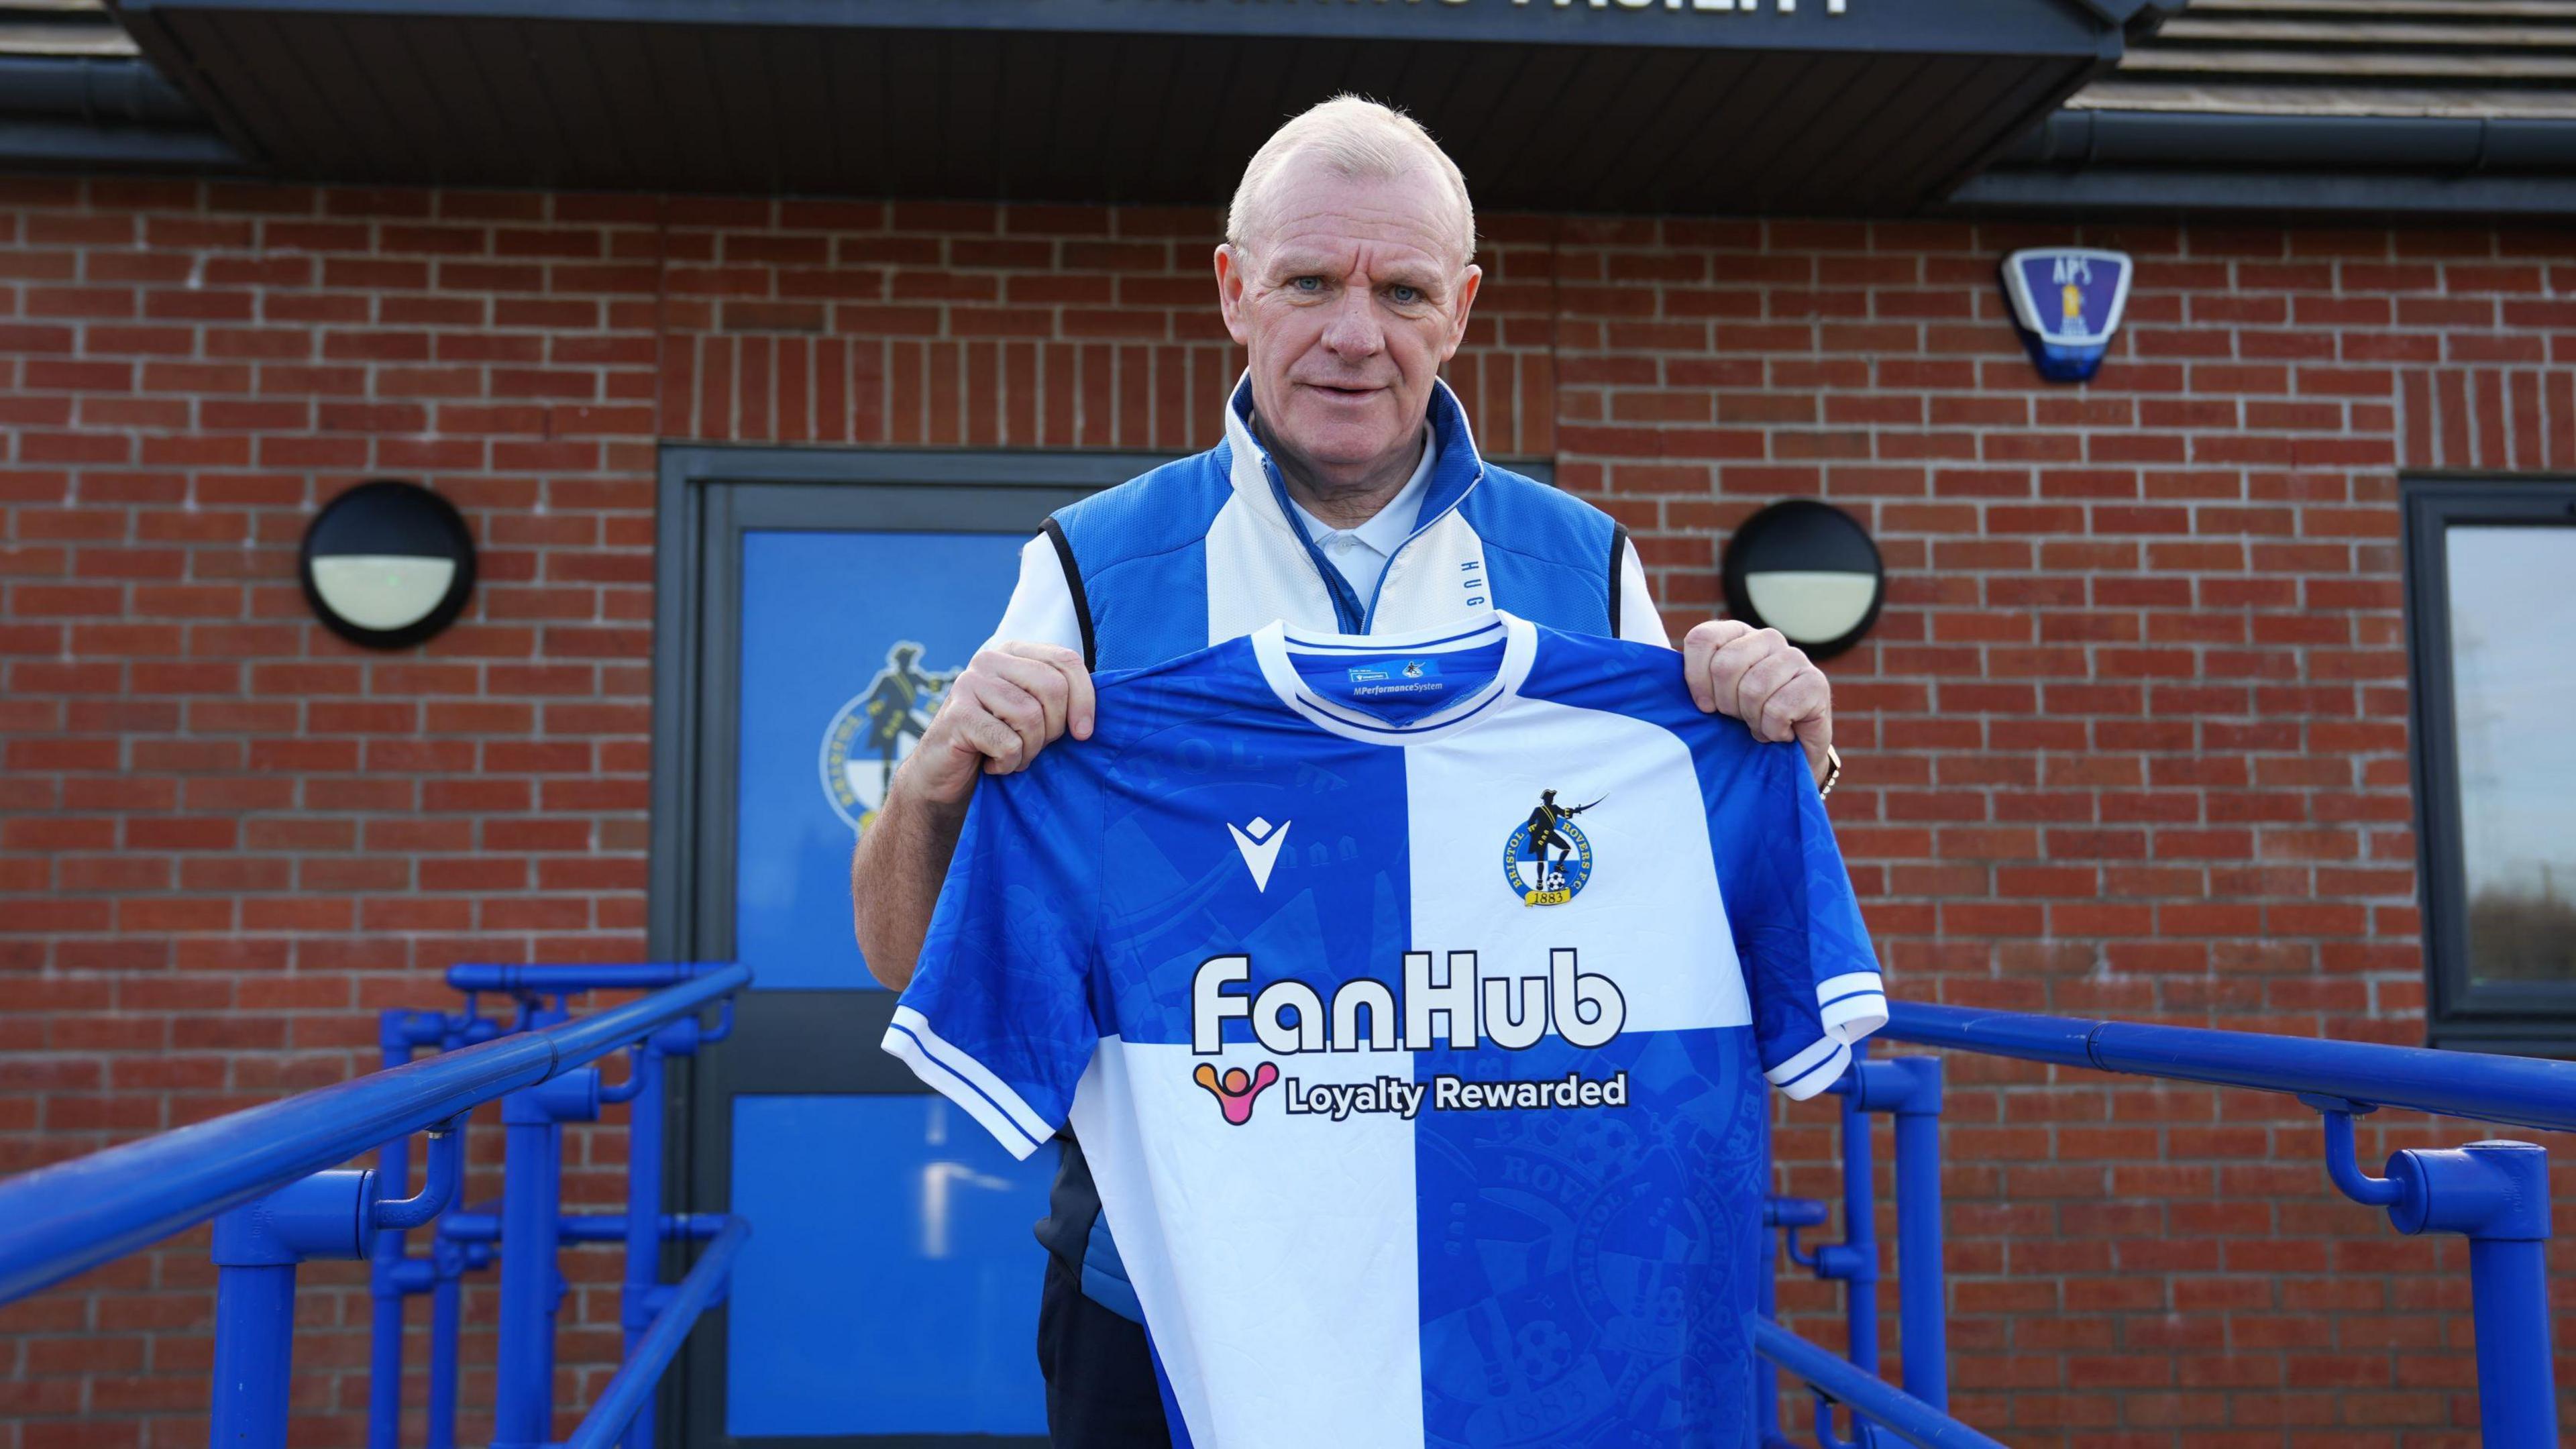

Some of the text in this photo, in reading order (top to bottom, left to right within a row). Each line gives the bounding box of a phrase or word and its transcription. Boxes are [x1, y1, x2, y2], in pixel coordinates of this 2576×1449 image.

[1354, 682, 1442, 696] MPerformanceSystem
[1506, 832, 1524, 888] BRISTOL
[1562, 822, 1590, 869] ROVERS
[1534, 892, 1563, 904] 1883
[1191, 948, 1626, 1056] FanHub
[1286, 1071, 1628, 1121] Loyalty Rewarded
